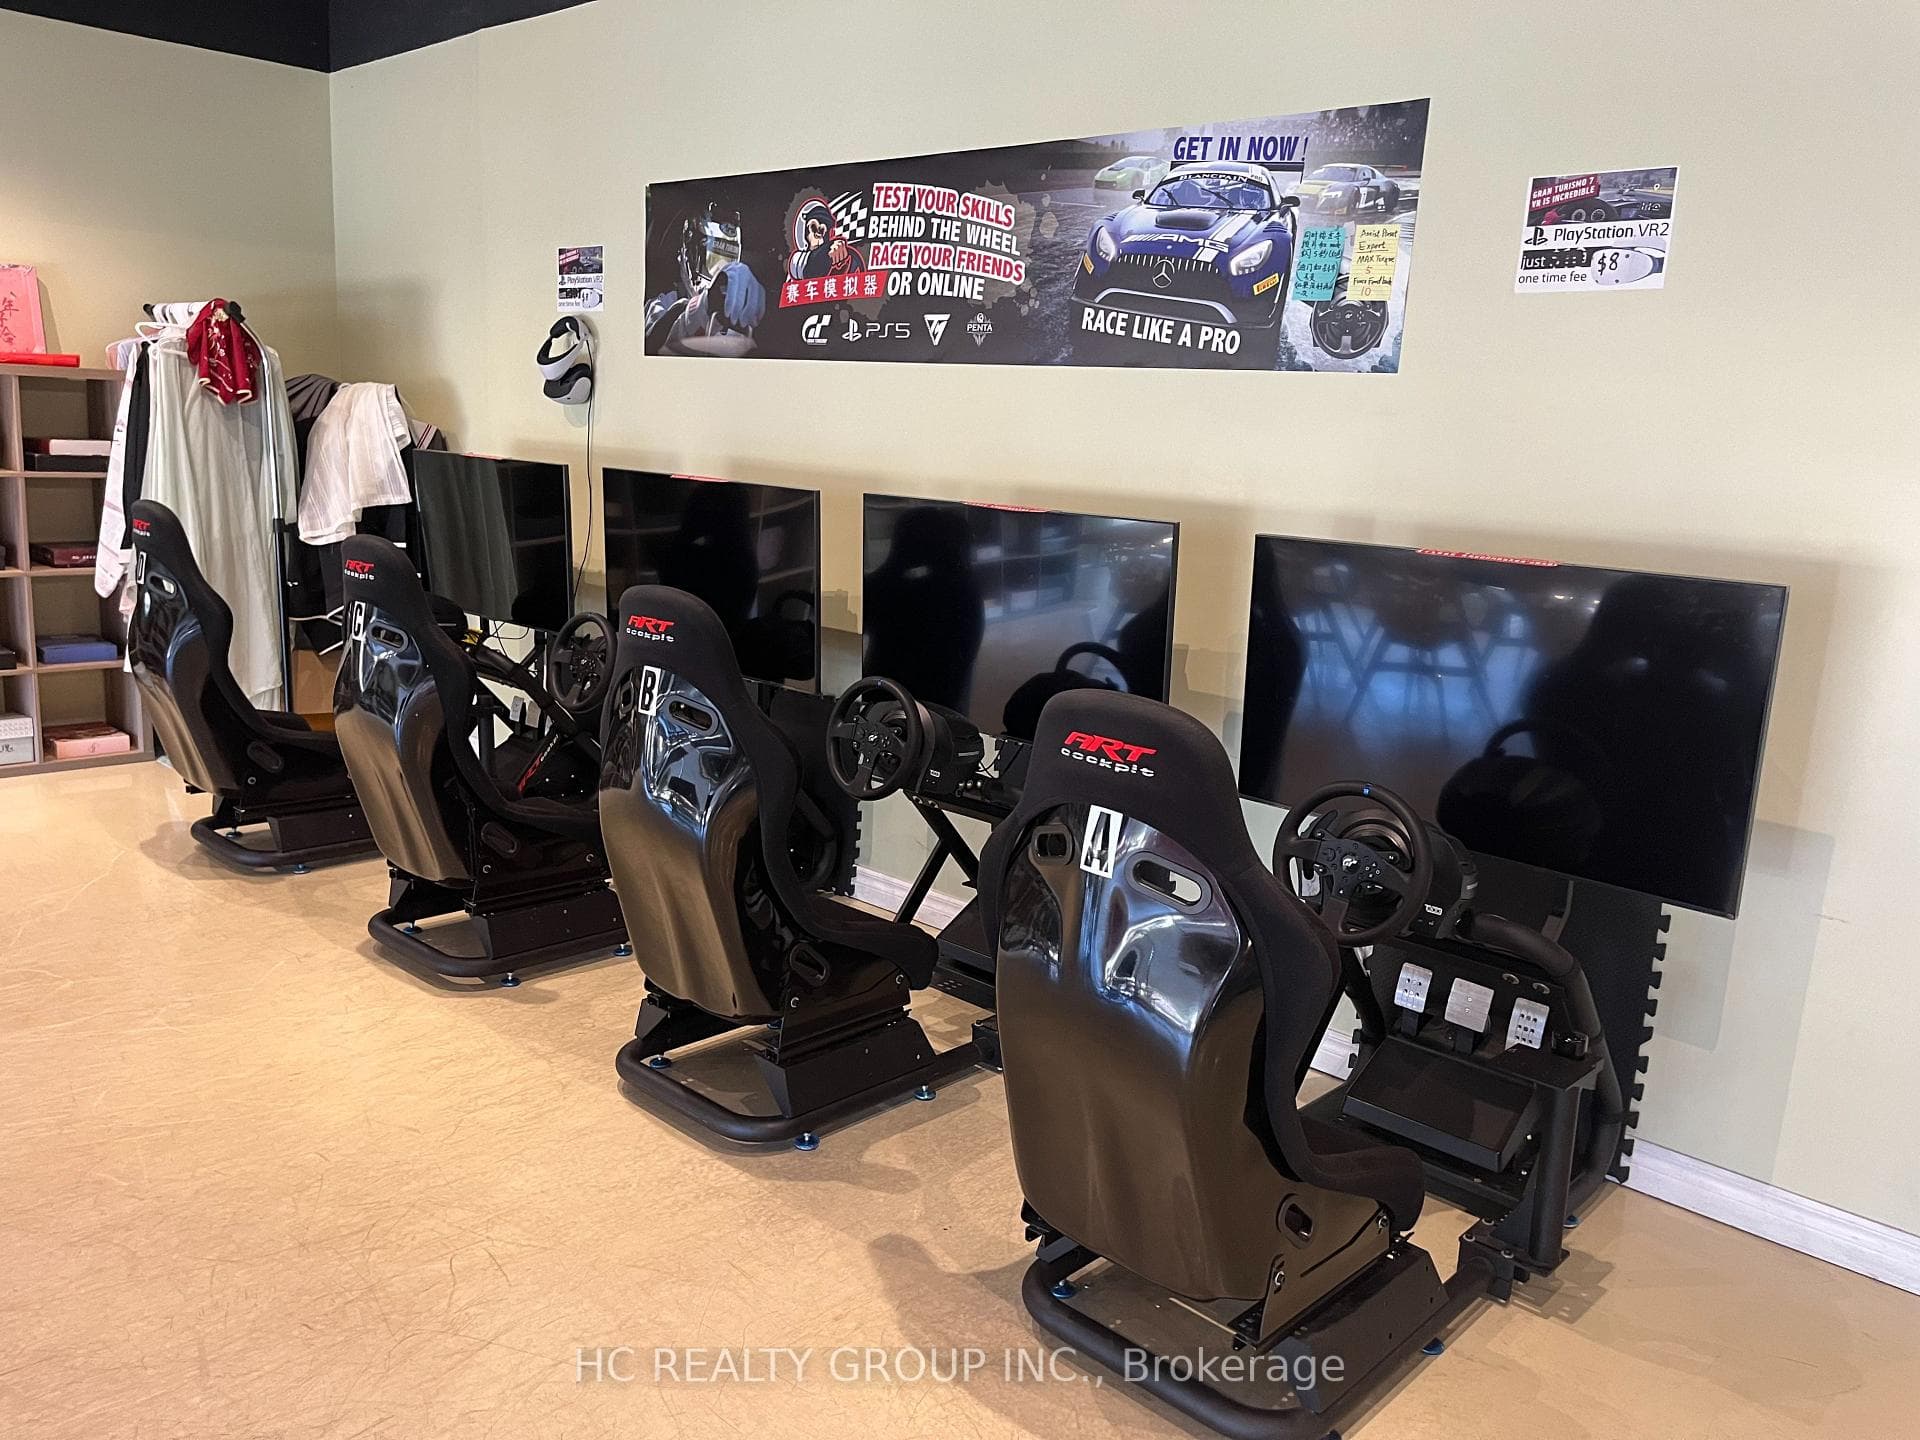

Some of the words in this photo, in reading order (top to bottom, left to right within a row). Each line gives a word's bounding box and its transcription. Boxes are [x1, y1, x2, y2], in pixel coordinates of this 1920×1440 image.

[1173, 136, 1213, 161] GET
[1218, 136, 1242, 161] IN
[1531, 199, 1541, 209] VR
[1542, 197, 1551, 207] IS
[1552, 185, 1596, 204] INCREDIBLE
[1532, 187, 1553, 199] GRAN
[1554, 178, 1588, 194] TURISMO
[1588, 176, 1595, 186] 7
[874, 185, 913, 210] TEST
[915, 187, 958, 214] YOUR
[960, 195, 1014, 229] SKILLS
[868, 215, 926, 239] BEHIND
[931, 217, 962, 242] THE
[966, 223, 1021, 256] WHEEL
[1553, 226, 1634, 245] PlayStation
[1638, 223, 1670, 237] VR2
[869, 244, 909, 268] RACE
[911, 244, 954, 269] YOUR
[955, 249, 1024, 283] FRIENDS
[1365, 265, 1373, 274] 5
[1521, 255, 1546, 270] just
[1597, 252, 1620, 276] $8
[786, 275, 878, 303] 赛车模拟器
[887, 271, 913, 297] OR
[917, 272, 985, 300] ONLINE
[1518, 275, 1539, 284] one
[1542, 272, 1567, 283] time
[1569, 270, 1587, 282] fee
[1360, 286, 1372, 296] 10
[865, 322, 911, 339] PS5
[966, 323, 993, 333] PENTA
[1081, 307, 1128, 336] RACE
[1132, 315, 1174, 344] LIKE
[1177, 323, 1192, 348] A
[1198, 325, 1241, 355] PRO
[353, 603, 364, 637] C
[628, 615, 675, 633] ART
[641, 669, 656, 711] B
[1064, 731, 1157, 763] ART
[1061, 747, 1155, 777] cockpit
[1084, 812, 1111, 873] A
